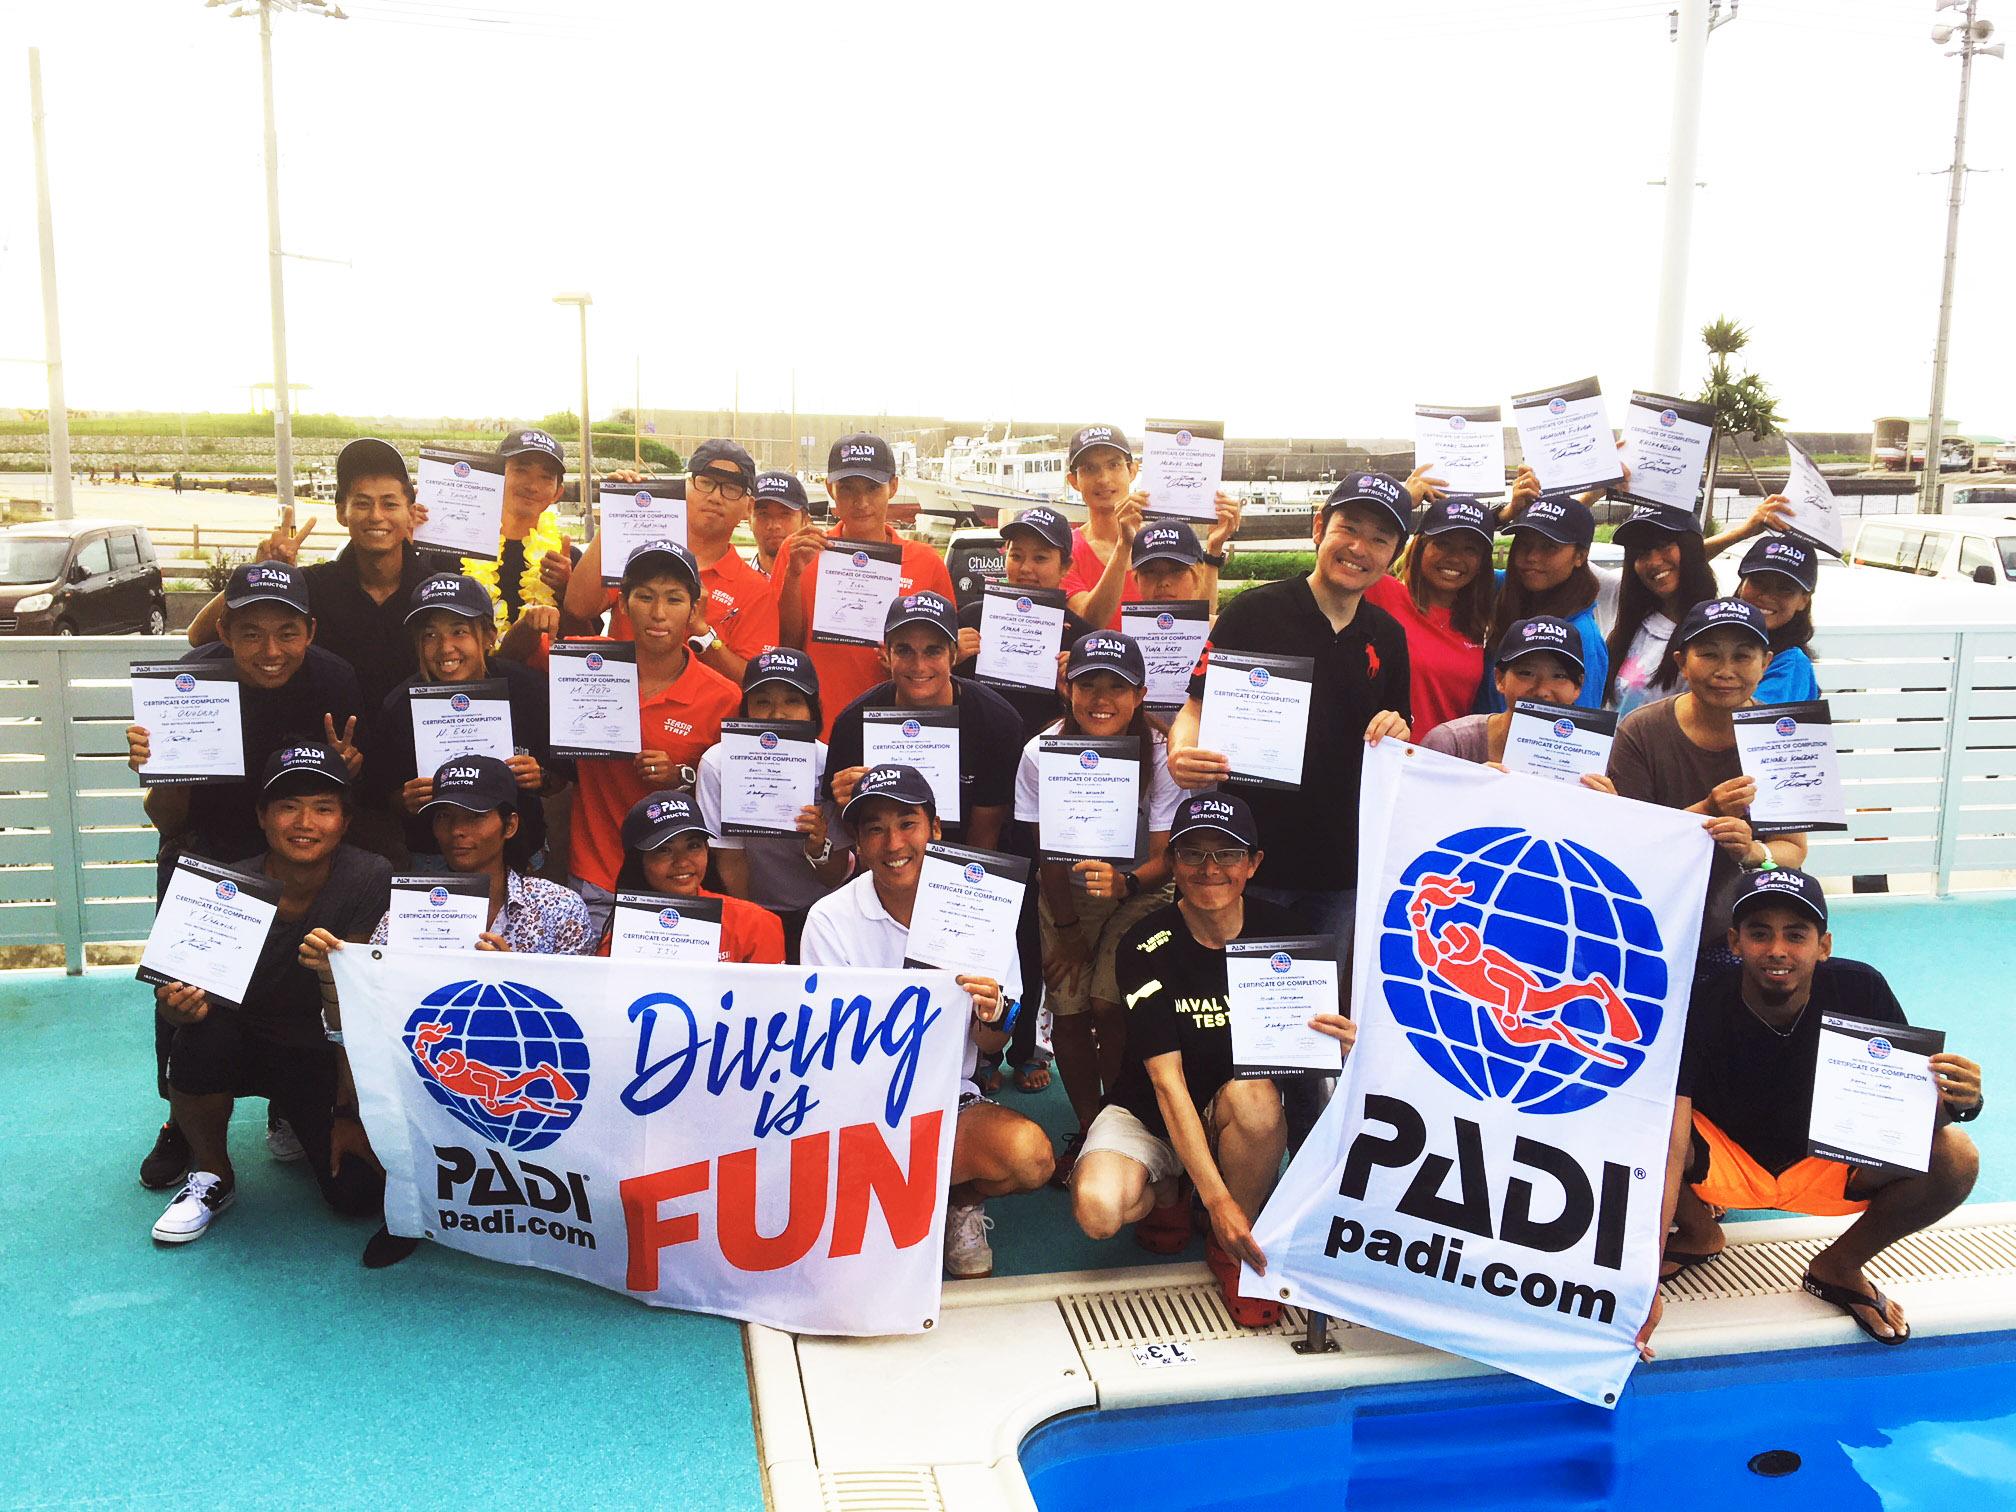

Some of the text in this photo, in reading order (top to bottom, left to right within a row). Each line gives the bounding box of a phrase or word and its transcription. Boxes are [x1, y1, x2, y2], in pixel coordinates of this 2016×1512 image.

[1089, 428, 1112, 436] PADI
[533, 434, 554, 448] PADI
[850, 445, 874, 456] PADI
[426, 480, 456, 488] CERTIFICATE
[464, 484, 496, 492] COMPLETION
[766, 478, 788, 488] PADI
[1372, 478, 1399, 499] PADI
[1358, 488, 1393, 503] INSTRUCTOR
[1030, 510, 1054, 523] PADI
[1460, 504, 1483, 520] PADI
[1537, 502, 1566, 517] PADI
[1448, 515, 1480, 524] INSTRUCTOR
[1154, 529, 1178, 539] PADI
[656, 541, 682, 555] PADI
[1146, 540, 1176, 548] INSTRUCTOR
[1766, 554, 1800, 566] INSTRUCTOR
[1779, 544, 1805, 562] PADI
[968, 556, 1004, 570] Chisai
[262, 569, 290, 583] PADI
[432, 581, 460, 590] PADI
[917, 596, 944, 612] PADI
[1720, 602, 1750, 616] PADI
[906, 608, 940, 616] INSTRUCTOR
[1538, 623, 1567, 638] PADI
[1098, 638, 1126, 653] PADI
[771, 654, 798, 666] PADI
[1214, 690, 1249, 698] CERTIFICATE
[1260, 696, 1300, 704] COMPLETION
[422, 718, 453, 726] CERTIFICATE
[664, 718, 692, 732] SEASIR
[664, 725, 688, 736] STAFF
[294, 748, 324, 759] PADI
[1517, 737, 1552, 748] CERTIFICATE
[1563, 744, 1600, 756] COMPLETION
[1747, 744, 1781, 752] CERTIFICATE
[449, 768, 480, 778] PADI
[870, 770, 900, 782] PADI
[660, 800, 689, 811] PADI
[1203, 800, 1234, 815] PADI
[654, 812, 690, 824] INSTRUCTOR
[1770, 872, 1804, 888] PADI
[928, 882, 963, 895] CERTIFICATE
[974, 892, 1012, 904] COMPLETION
[176, 894, 212, 910] CERTIFICATE
[223, 908, 262, 924] COMPLETION
[623, 933, 660, 941] CERTIFICATE
[671, 937, 710, 946] COMPLETION
[1174, 997, 1222, 1012] NAVAL
[620, 974, 941, 1128] Diving
[1828, 1058, 1868, 1071] CERTIFICATE
[1882, 1068, 1927, 1082] COMPLETION
[755, 1068, 820, 1138] is
[436, 1146, 591, 1223] PADI
[1338, 1094, 1631, 1271] PADI
[620, 1110, 944, 1292] FUN
[438, 1208, 597, 1250] padi.com
[1324, 1215, 1617, 1324] padi.com
